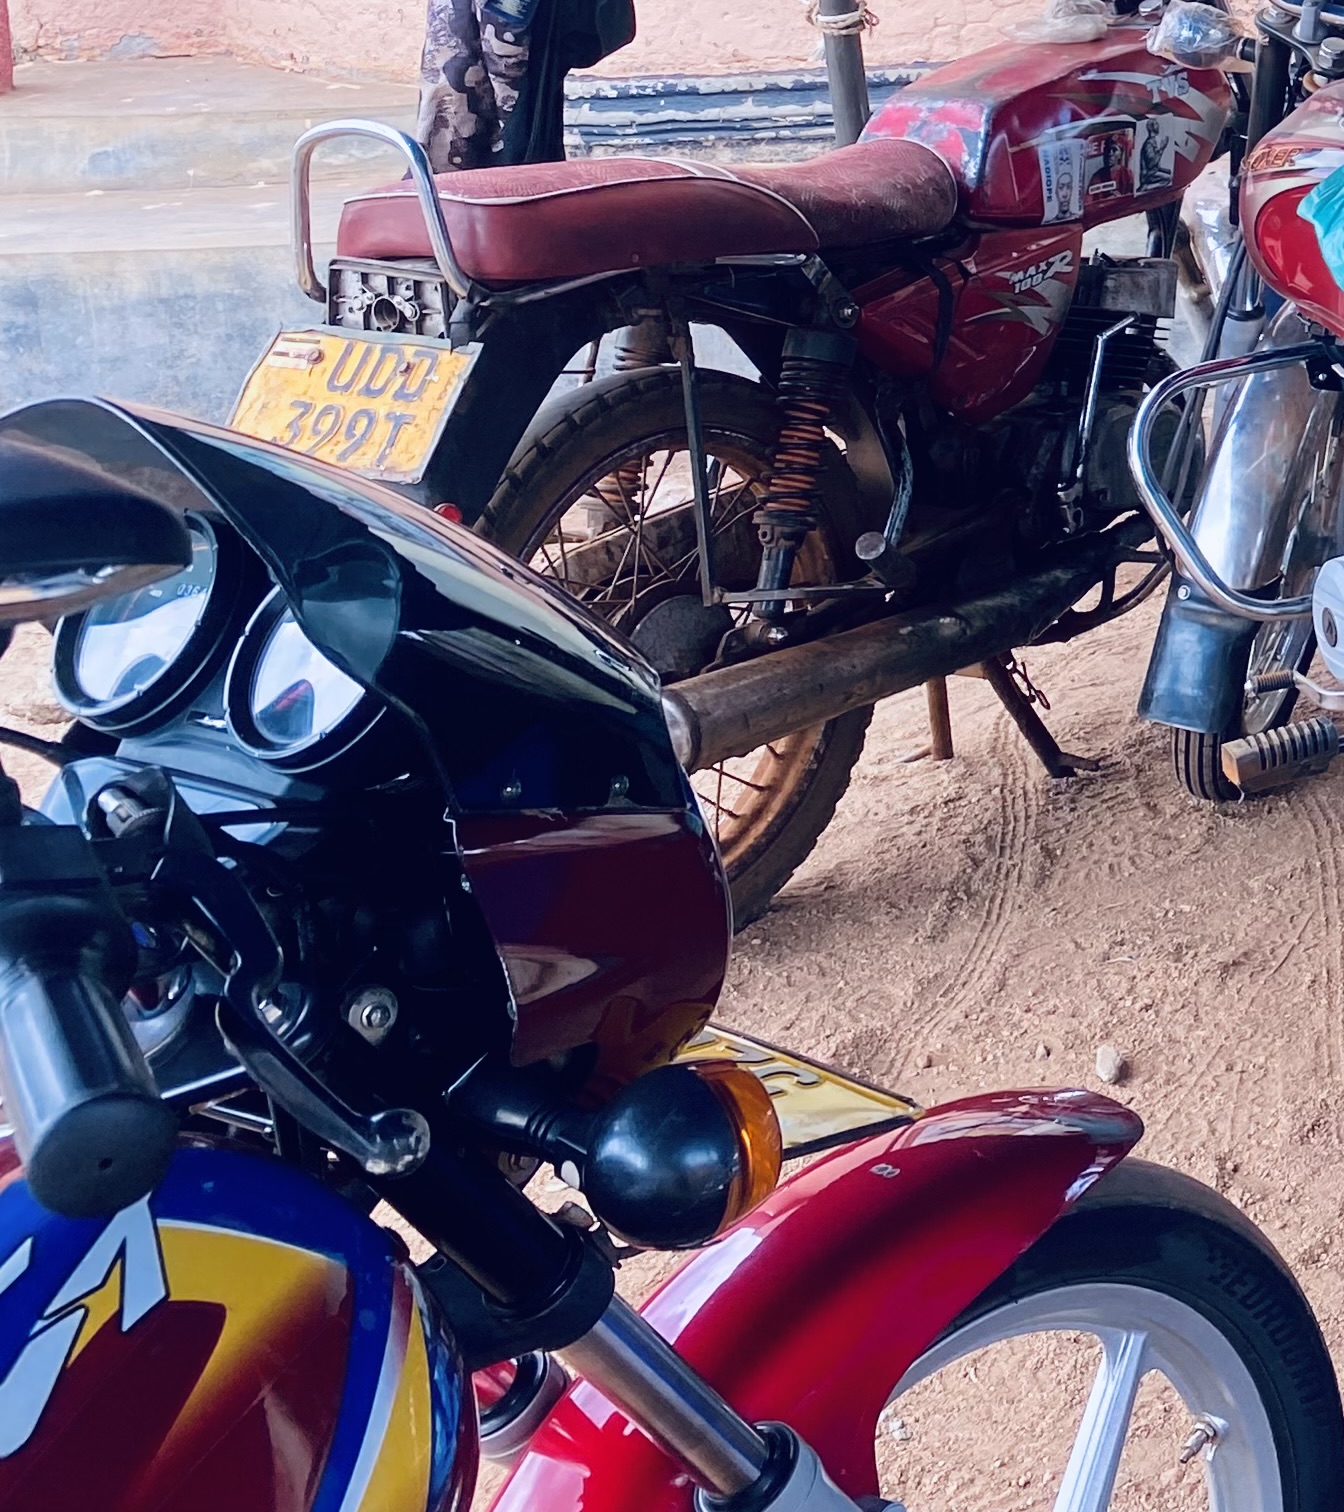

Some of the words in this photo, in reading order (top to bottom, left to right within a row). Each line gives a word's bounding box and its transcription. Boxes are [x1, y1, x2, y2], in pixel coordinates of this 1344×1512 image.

[1145, 71, 1190, 104] TVS
[1009, 260, 1048, 285] MAX
[1014, 272, 1044, 295] 100
[271, 399, 416, 469] 399T
